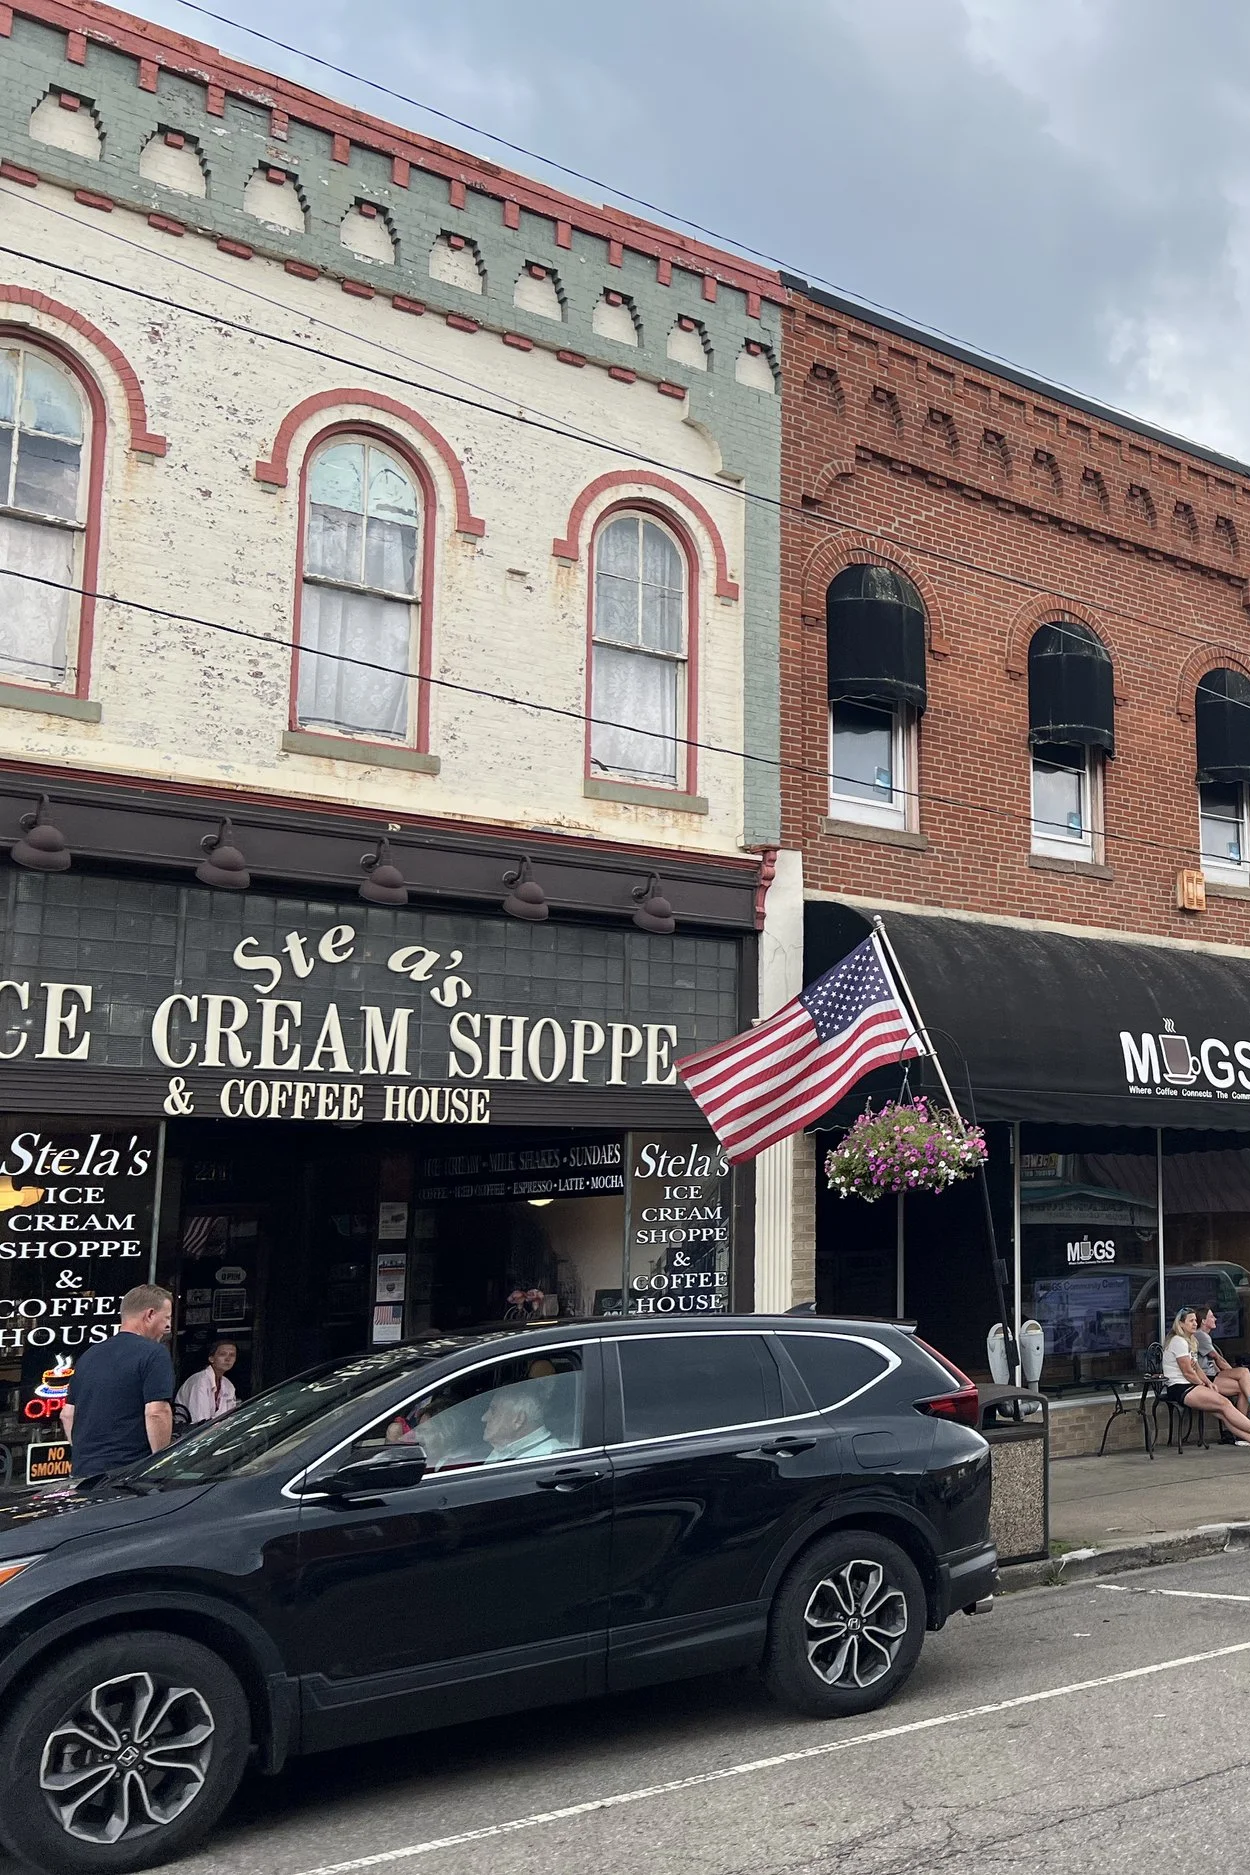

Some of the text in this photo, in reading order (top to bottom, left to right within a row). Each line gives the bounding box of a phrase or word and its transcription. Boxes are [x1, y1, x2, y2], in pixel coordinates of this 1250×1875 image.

[152, 994, 414, 1075] CREAM
[449, 1012, 678, 1085] SHOPPE
[163, 1077, 490, 1124] & COFFEE HOUSE
[1129, 1085, 1152, 1095] Where
[1155, 1087, 1178, 1096] Coffee
[1182, 1088, 1212, 1098] Connects
[1216, 1090, 1229, 1099] The
[1, 1132, 151, 1176] Stela's
[569, 1143, 621, 1167] SUNDAES
[635, 1143, 730, 1178] Stela's
[558, 1177, 585, 1192] LATTE
[590, 1174, 624, 1189] MOCHA
[664, 1185, 703, 1200] ICE
[44, 1187, 105, 1204] ICE
[8, 1214, 136, 1231] CREAM
[641, 1206, 723, 1221] CREAM
[636, 1227, 728, 1244] SHOPPE
[0, 1240, 142, 1260] SHOPPE
[673, 1251, 691, 1267] &
[55, 1269, 83, 1289] &
[633, 1271, 728, 1291] COFFEE
[0, 1297, 125, 1319] COFFE
[636, 1293, 724, 1314] HOUSE
[24, 1397, 66, 1418] OP
[48, 1446, 65, 1461] NO
[31, 1461, 73, 1478] SMOKIN
